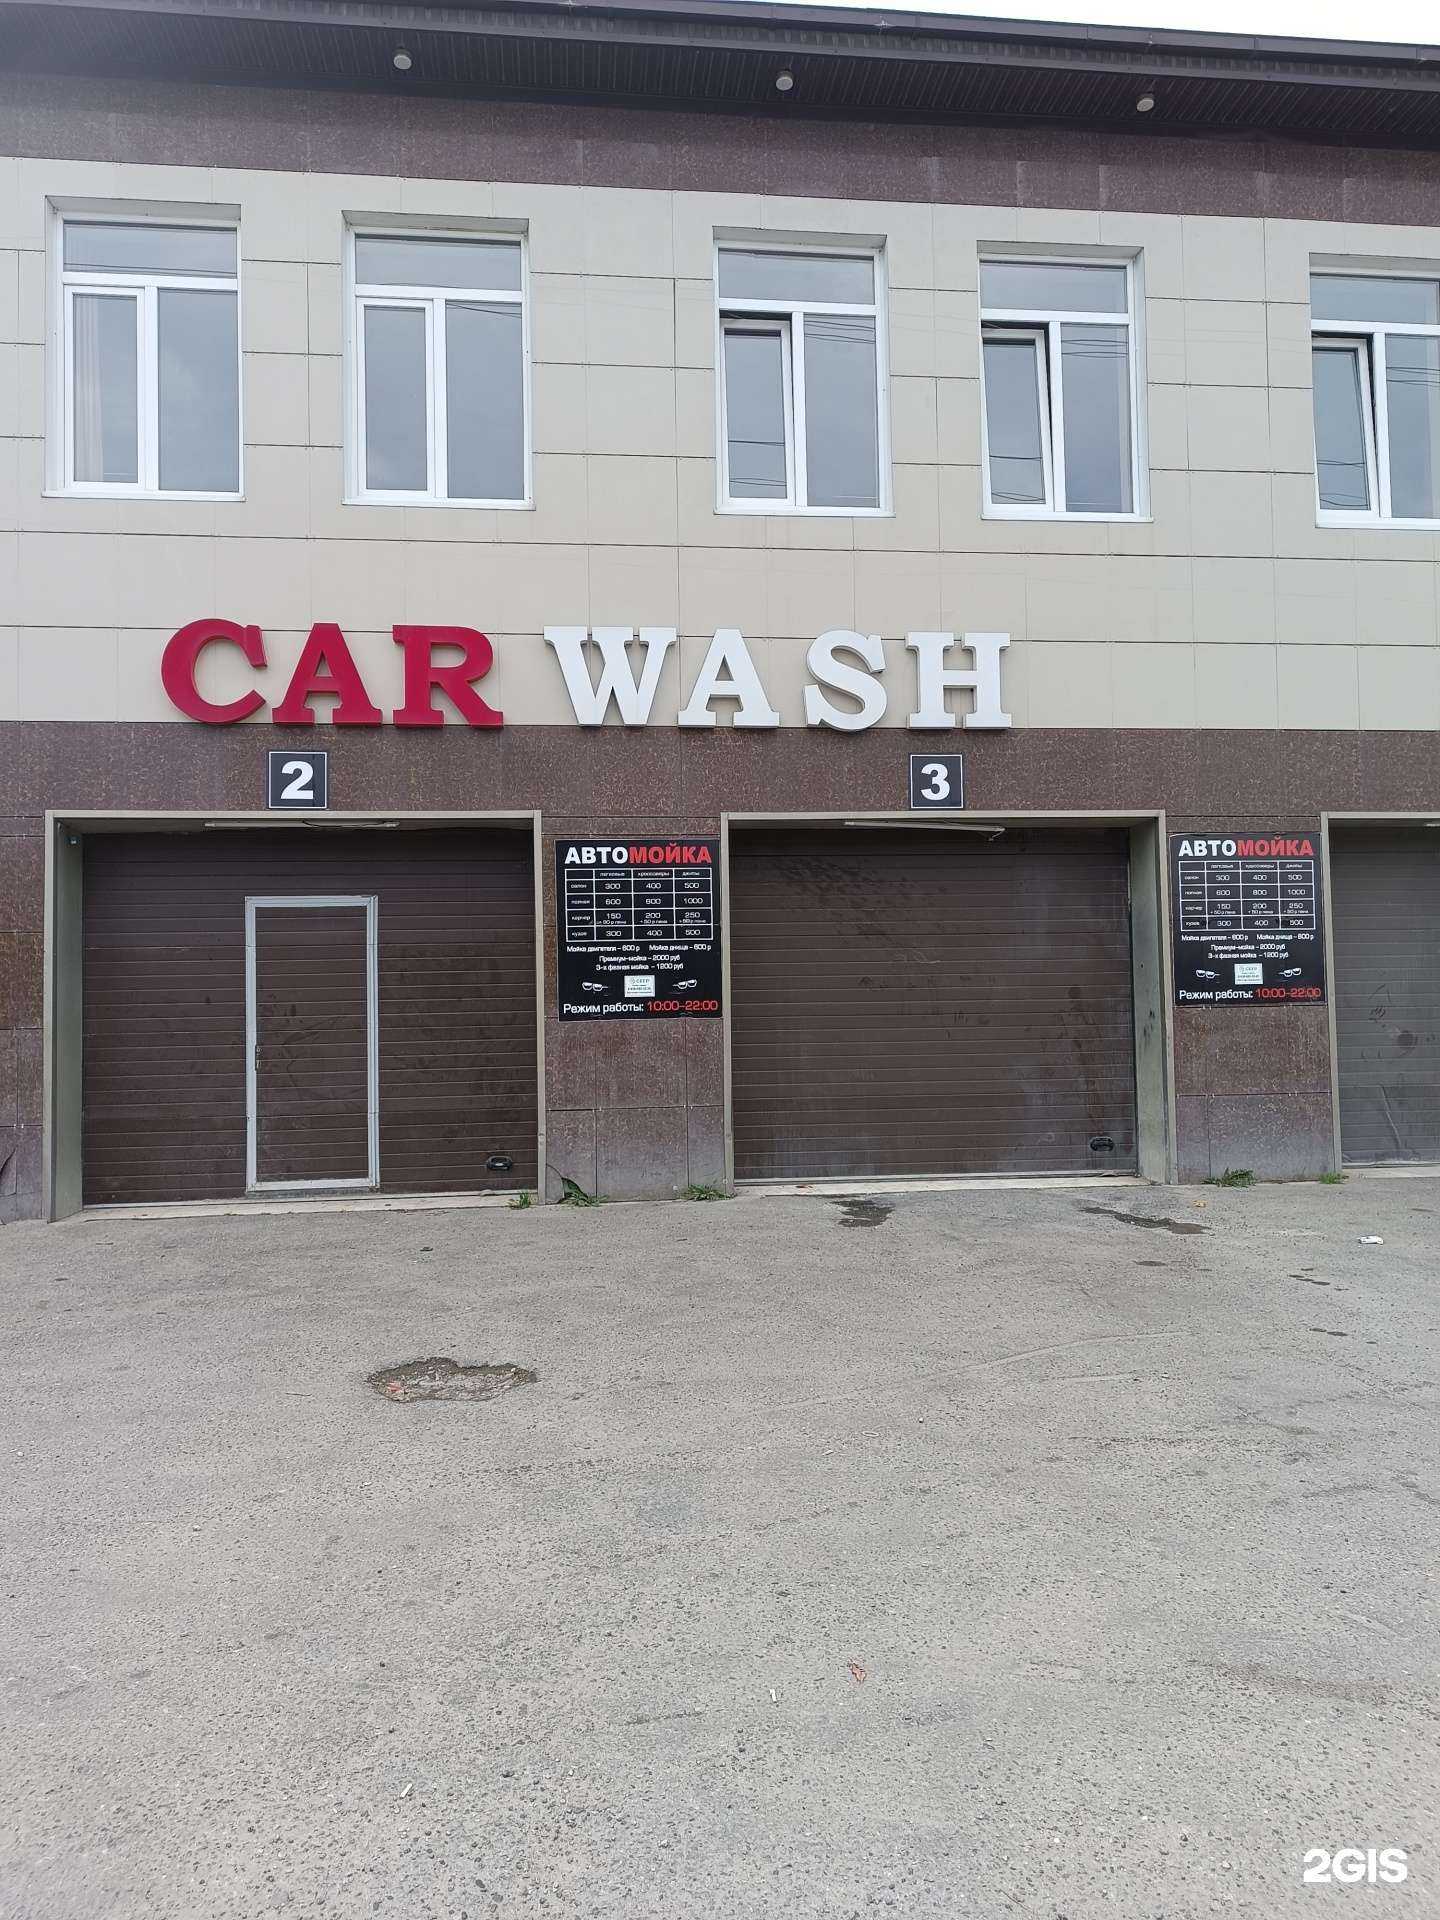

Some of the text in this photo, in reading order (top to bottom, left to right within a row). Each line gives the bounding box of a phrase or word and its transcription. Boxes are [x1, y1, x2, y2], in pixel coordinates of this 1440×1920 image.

[161, 618, 1013, 732] CAR WASH
[280, 760, 314, 800] 2
[920, 763, 951, 801] 3
[564, 842, 712, 864] АВТОМОЙКА
[1178, 835, 1315, 857] АВТОМОЙКА
[606, 912, 622, 920] 150
[684, 911, 701, 919] 250
[646, 929, 663, 937] 400
[1179, 989, 1214, 1000] Режим
[1215, 988, 1254, 1001] работы:
[563, 1003, 601, 1014] Режим
[602, 1001, 644, 1015] работы:
